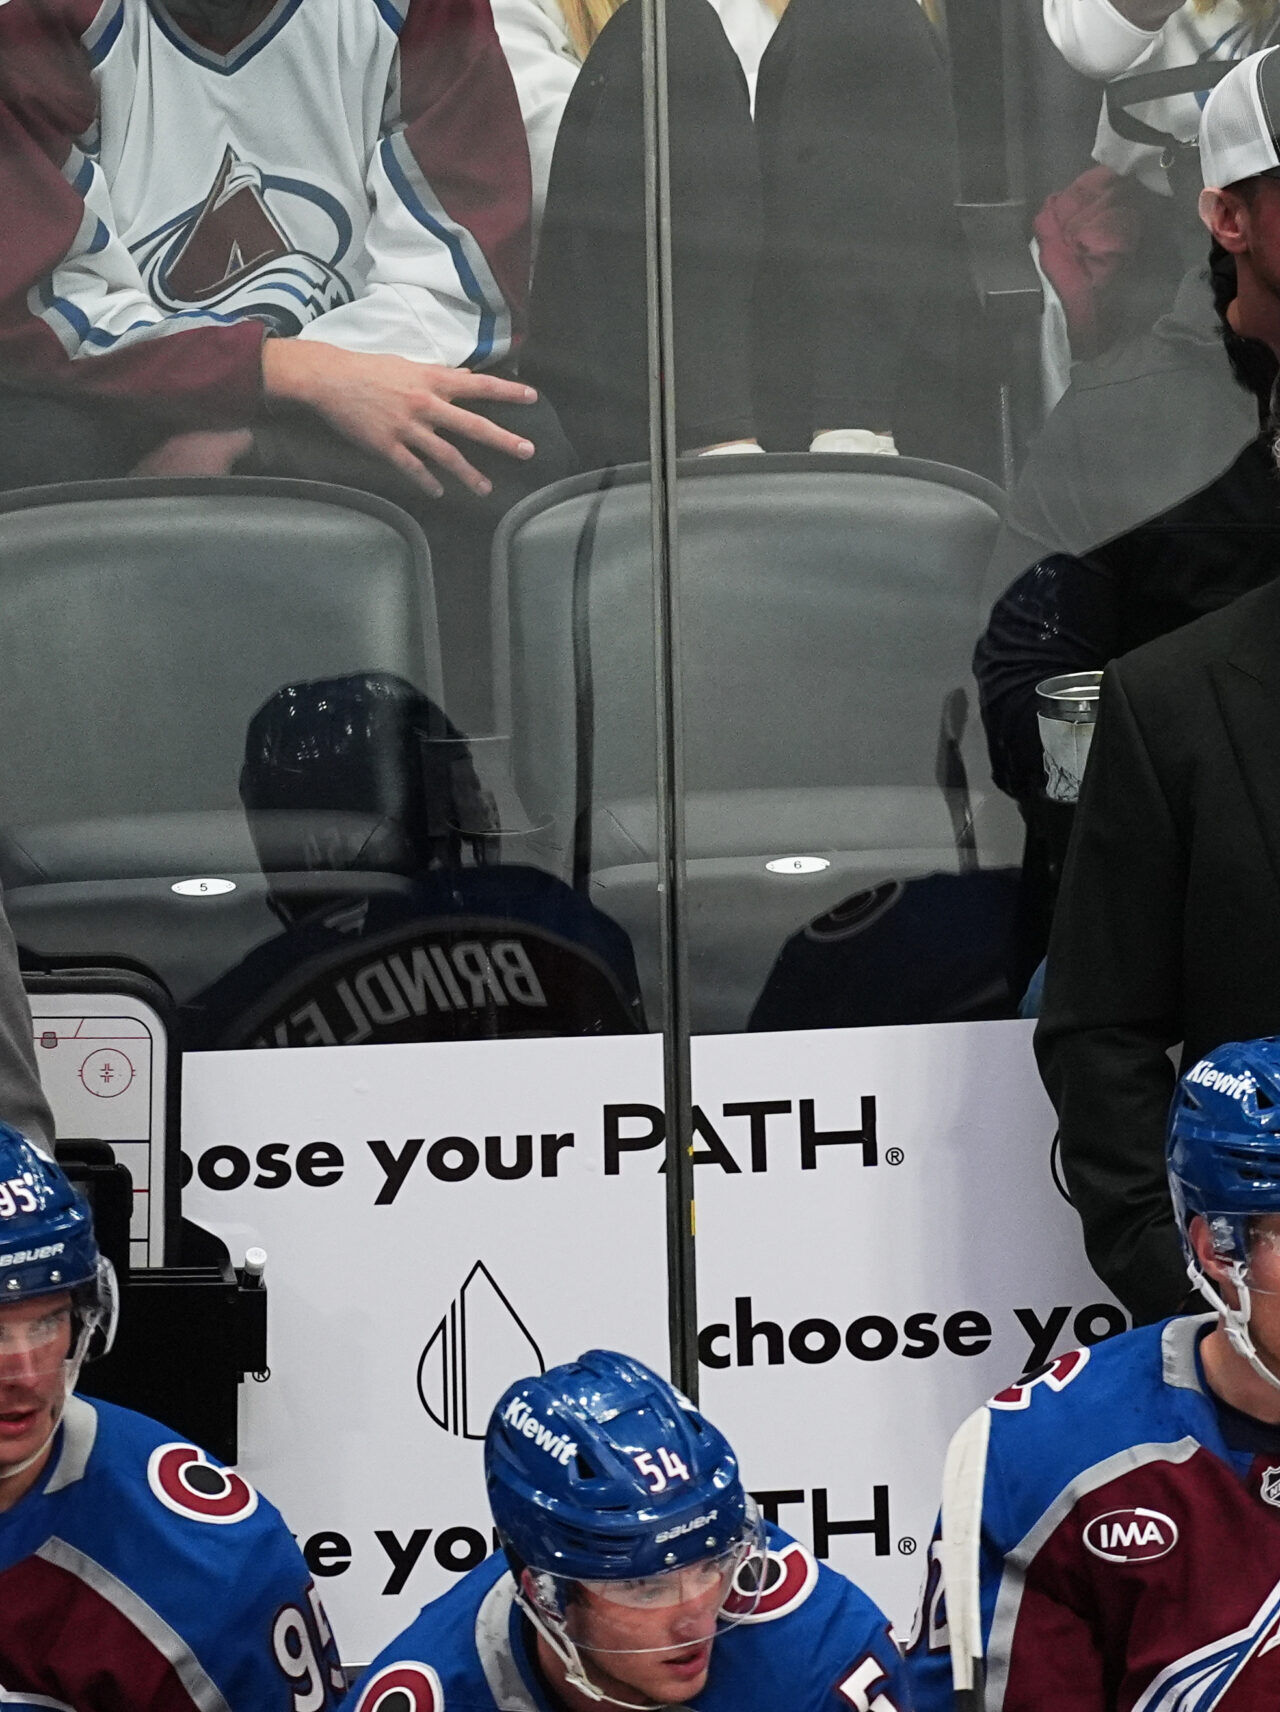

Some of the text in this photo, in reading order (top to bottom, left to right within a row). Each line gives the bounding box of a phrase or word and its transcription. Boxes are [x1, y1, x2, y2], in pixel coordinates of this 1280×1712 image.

[200, 882, 209, 892] 5
[1186, 1059, 1257, 1101] Kiewit
[181, 1141, 344, 1191] ose
[366, 1132, 575, 1206] your
[697, 1296, 993, 1369] choose
[503, 1396, 577, 1466] Kiewit
[634, 1446, 691, 1493] 54
[655, 1509, 718, 1544] BAUER
[1100, 1520, 1165, 1549] IMA
[374, 1525, 506, 1596] yo
